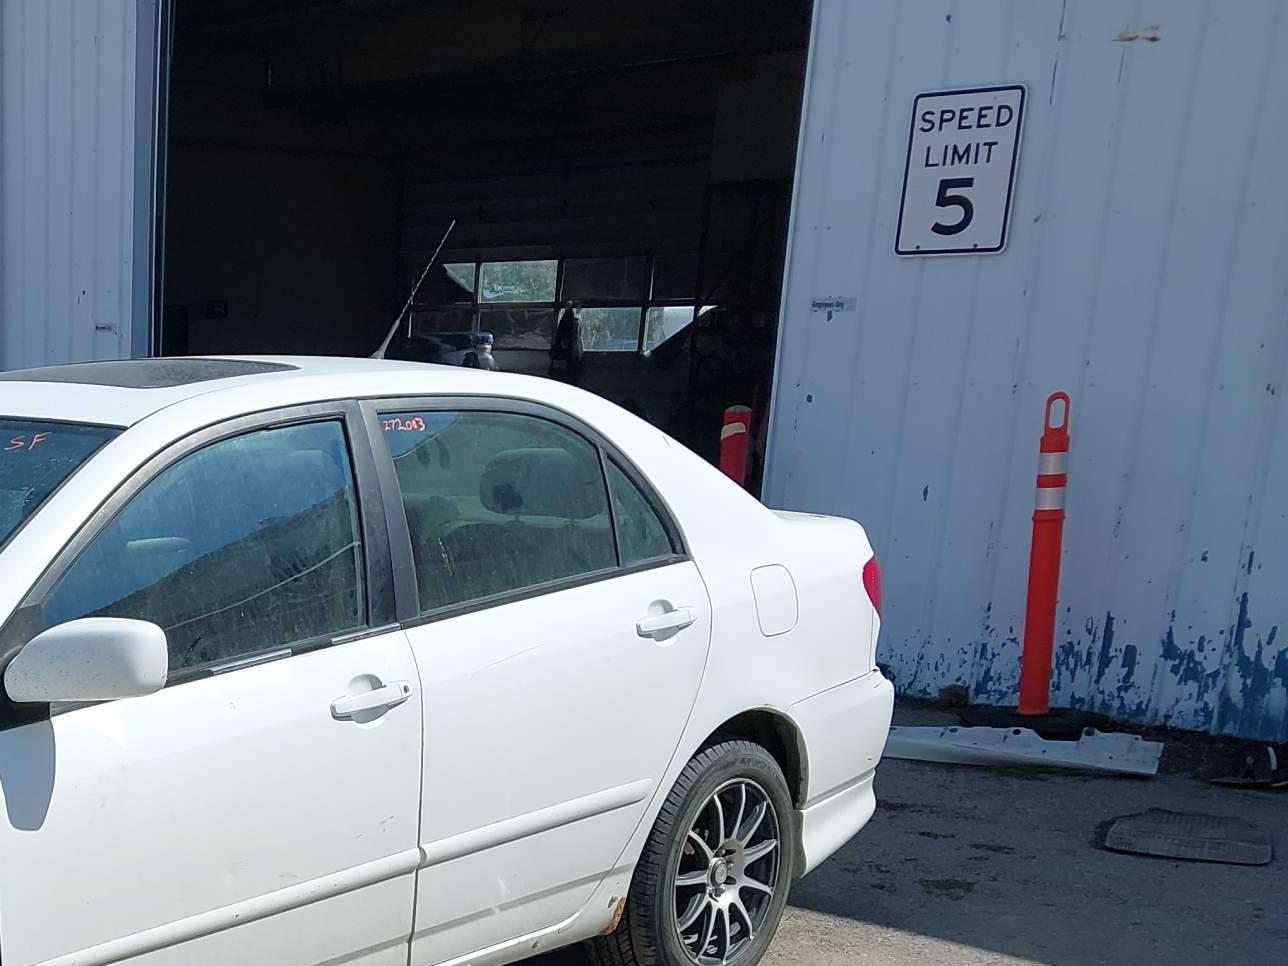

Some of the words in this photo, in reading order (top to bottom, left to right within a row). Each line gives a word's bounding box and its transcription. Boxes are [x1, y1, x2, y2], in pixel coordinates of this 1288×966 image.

[919, 104, 1013, 133] SPEED
[924, 141, 999, 168] LIMIT
[930, 177, 975, 236] 5
